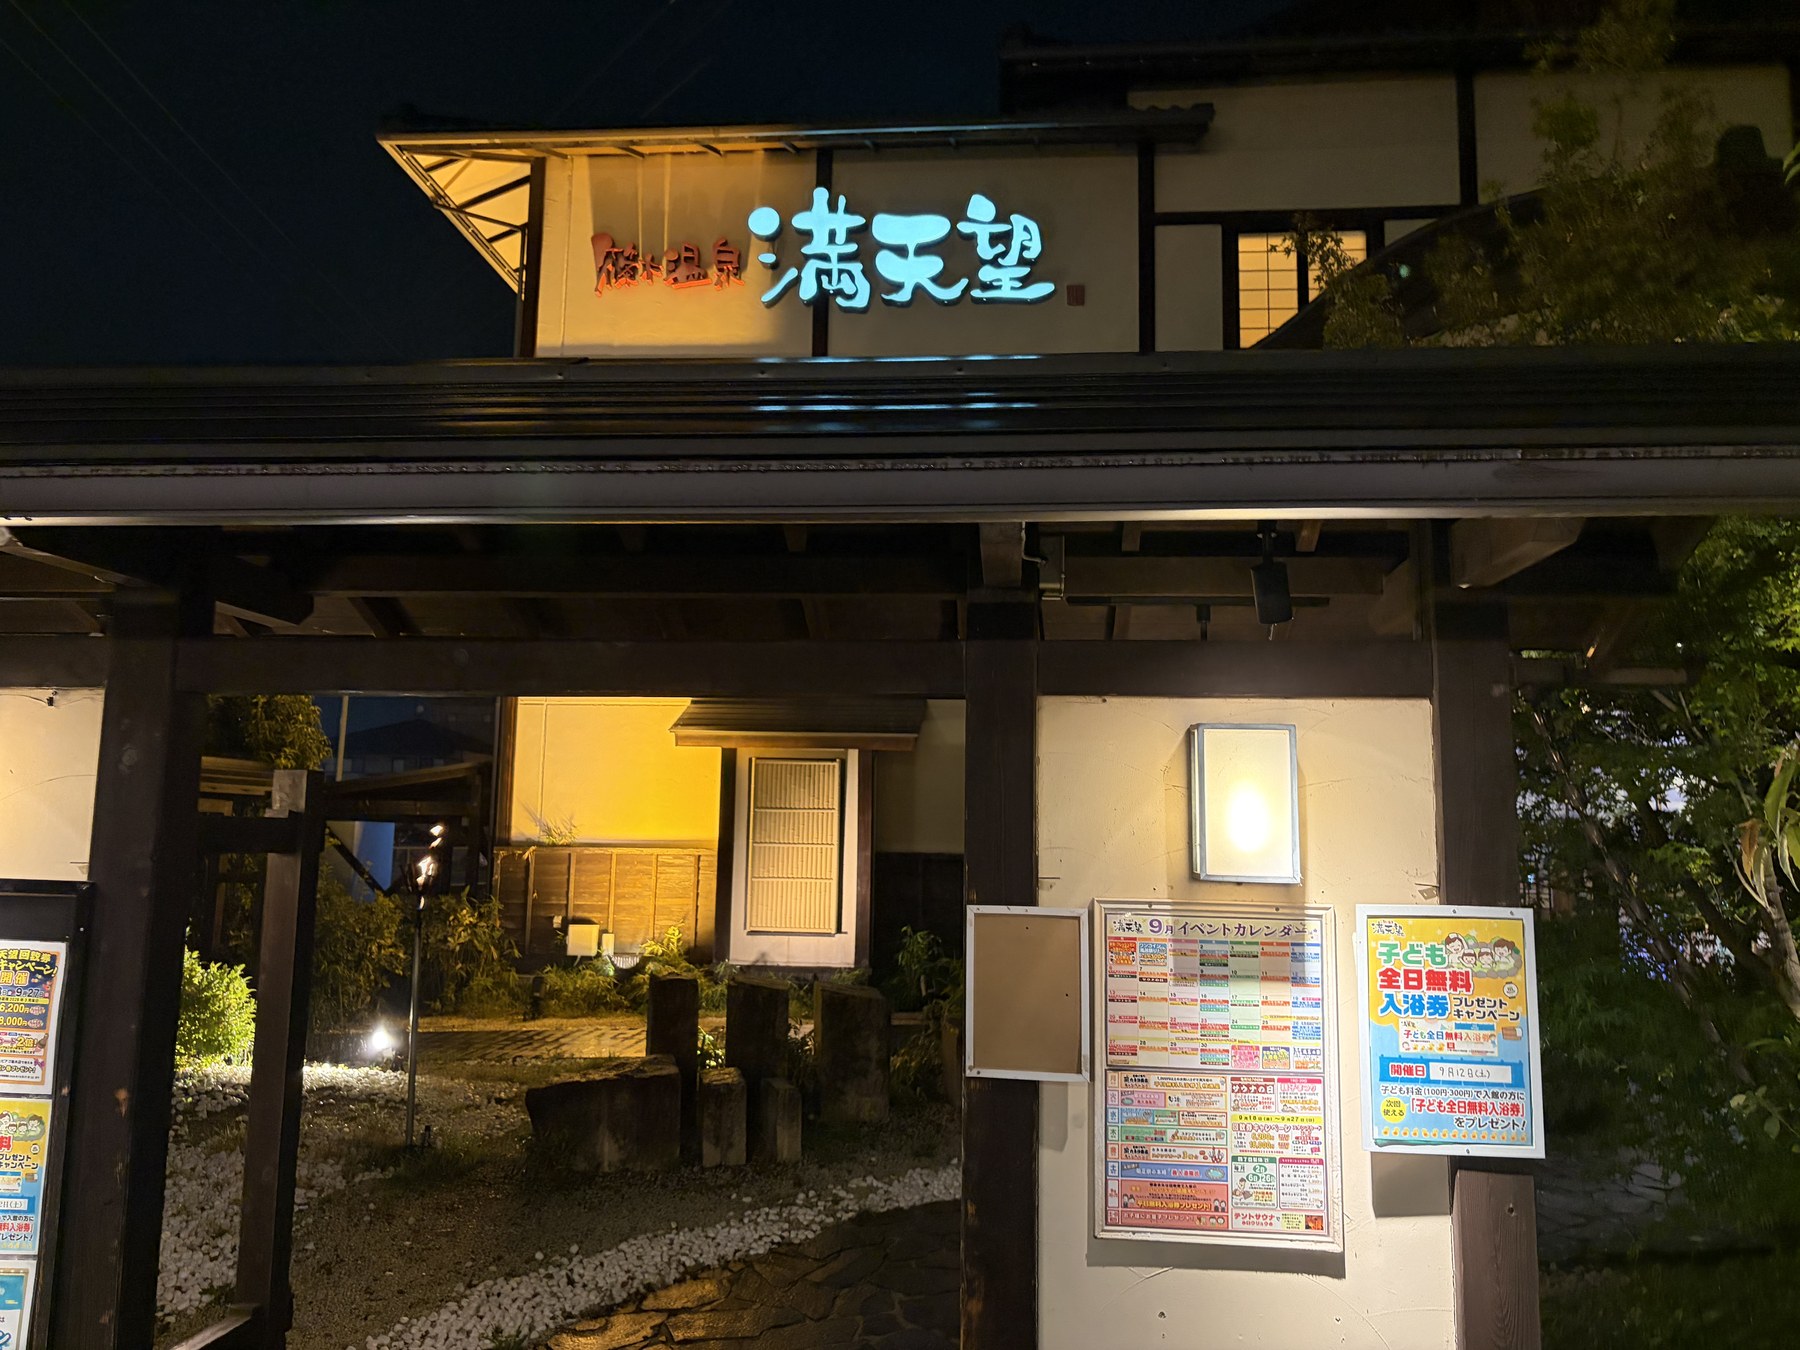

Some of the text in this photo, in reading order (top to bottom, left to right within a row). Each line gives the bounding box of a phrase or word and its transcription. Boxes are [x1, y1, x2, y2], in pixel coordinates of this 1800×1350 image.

[748, 187, 1056, 308] 満天望
[1378, 942, 1447, 966] 子ども
[1378, 967, 1472, 993] 全日無料
[1380, 993, 1449, 1017] 入浴券
[1453, 997, 1508, 1010] プレゼント
[1453, 1009, 1520, 1021] キャンペーン
[1390, 1064, 1426, 1077] 開催日
[1383, 1108, 1405, 1117] 使える
